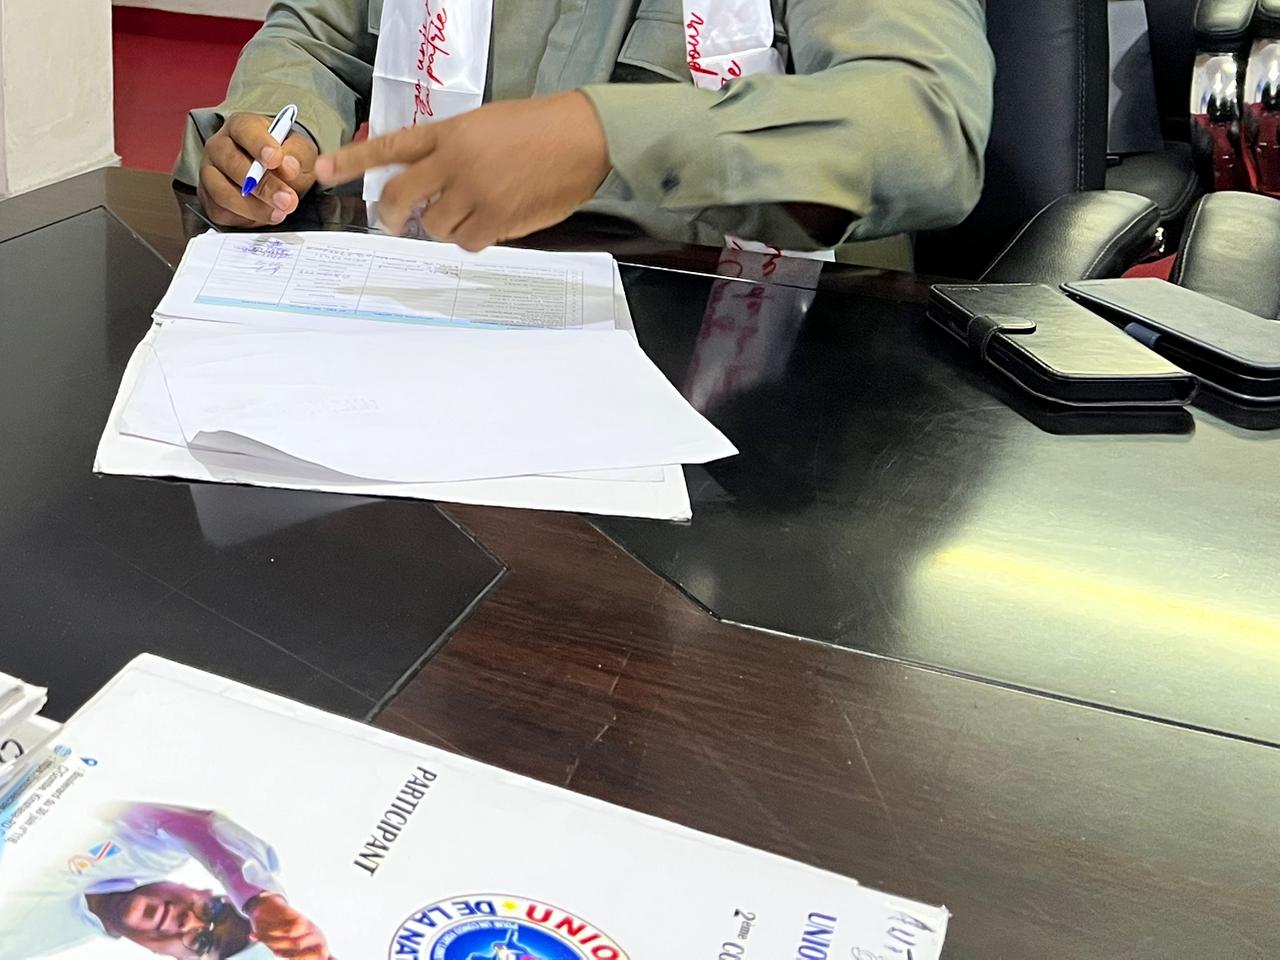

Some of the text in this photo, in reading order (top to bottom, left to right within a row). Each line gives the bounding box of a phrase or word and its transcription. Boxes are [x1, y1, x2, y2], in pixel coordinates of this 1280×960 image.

[686, 11, 719, 76] pour
[353, 766, 438, 877] PARTICIPANT
[412, 905, 454, 928] LA
[452, 899, 498, 917] DE
